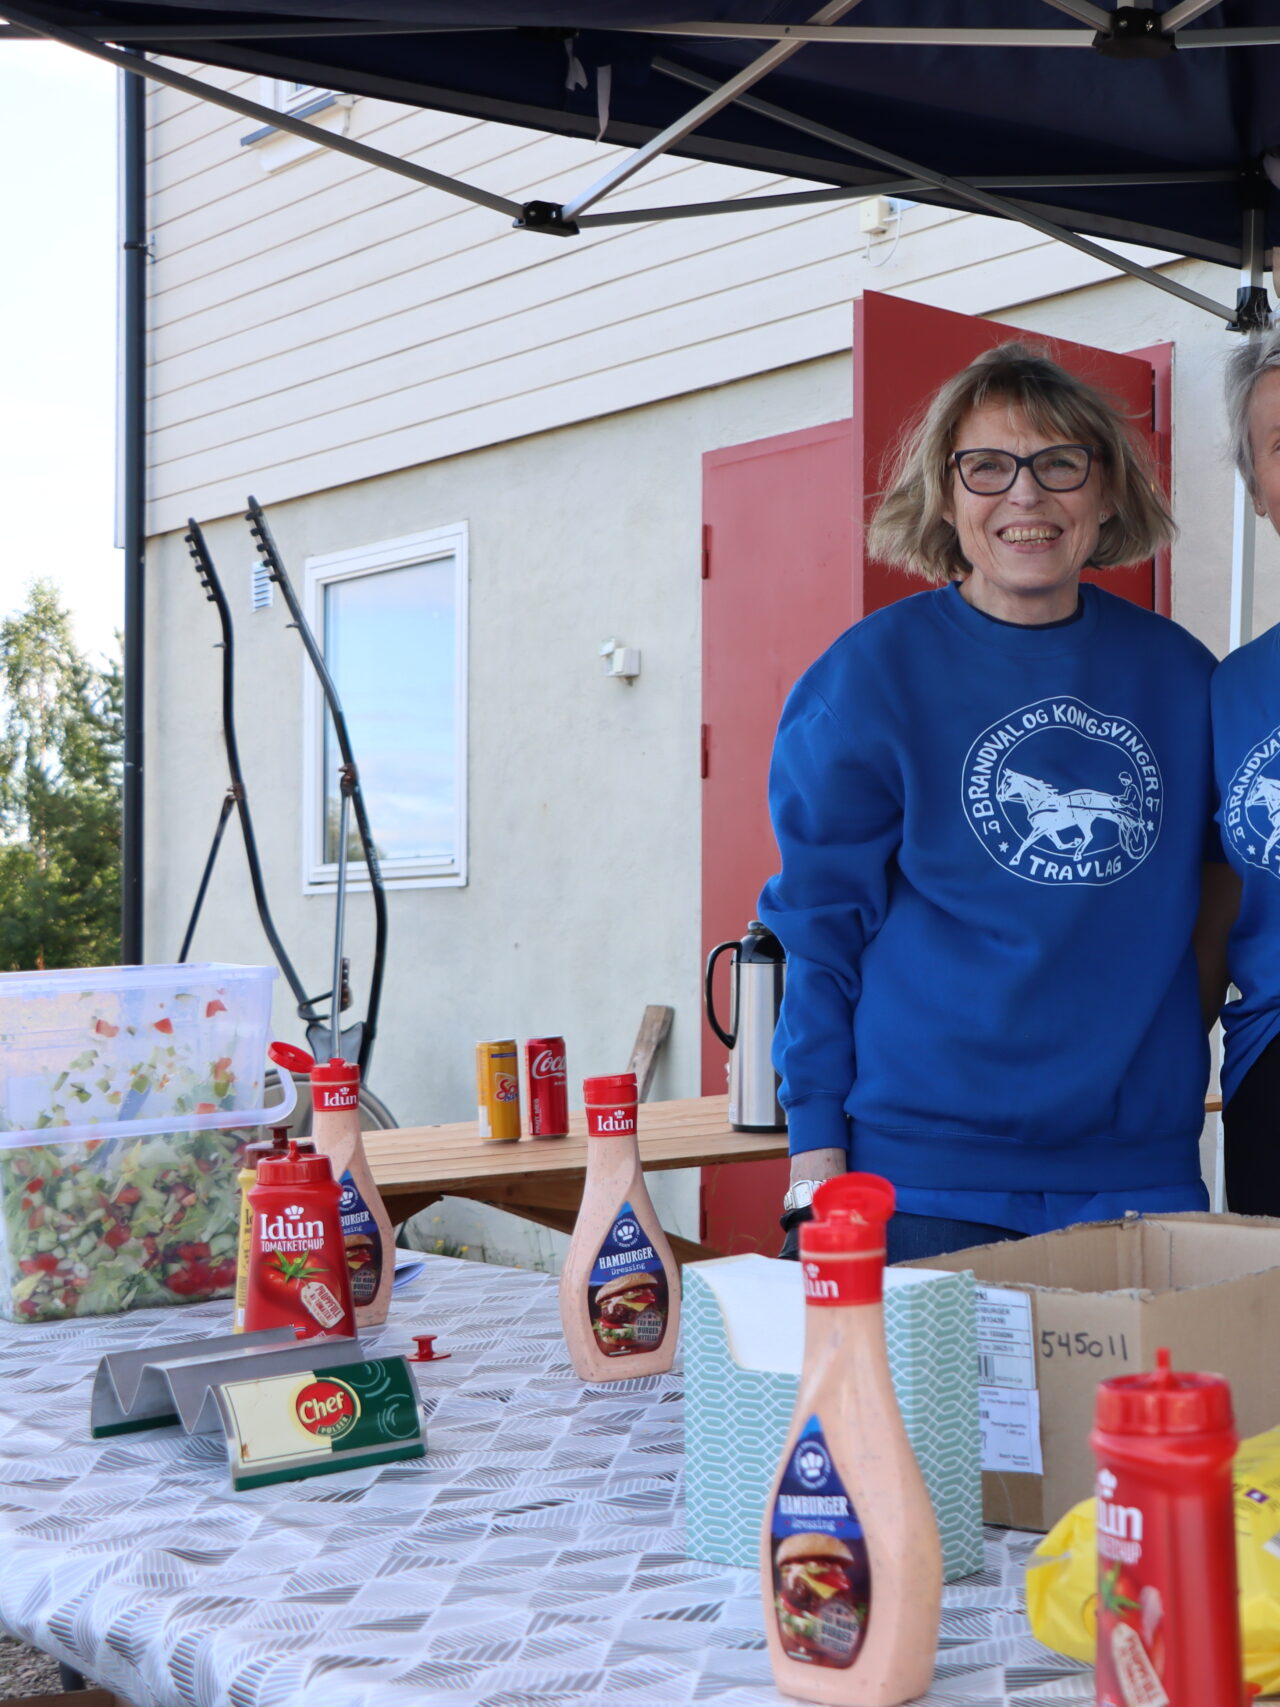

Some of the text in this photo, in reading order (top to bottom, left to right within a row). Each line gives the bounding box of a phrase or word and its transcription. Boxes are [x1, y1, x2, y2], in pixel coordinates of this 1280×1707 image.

[968, 704, 1160, 819] BRANDVAL OG KONGSVINGER
[1145, 796, 1160, 812] 97
[982, 820, 1002, 836] 19
[1233, 828, 1246, 843] 19
[1029, 855, 1122, 881] TRAVLAG
[324, 1092, 357, 1106] Idun
[597, 1115, 634, 1131] Idun
[260, 1213, 324, 1240] Idun
[261, 1237, 325, 1253] TOMATKETCHUP
[599, 1247, 653, 1270] HAMBURGER
[611, 1262, 646, 1276] Dressing
[1041, 1330, 1128, 1361] 545011
[300, 1391, 345, 1424] Chef
[779, 1494, 850, 1517] HAMBURGER
